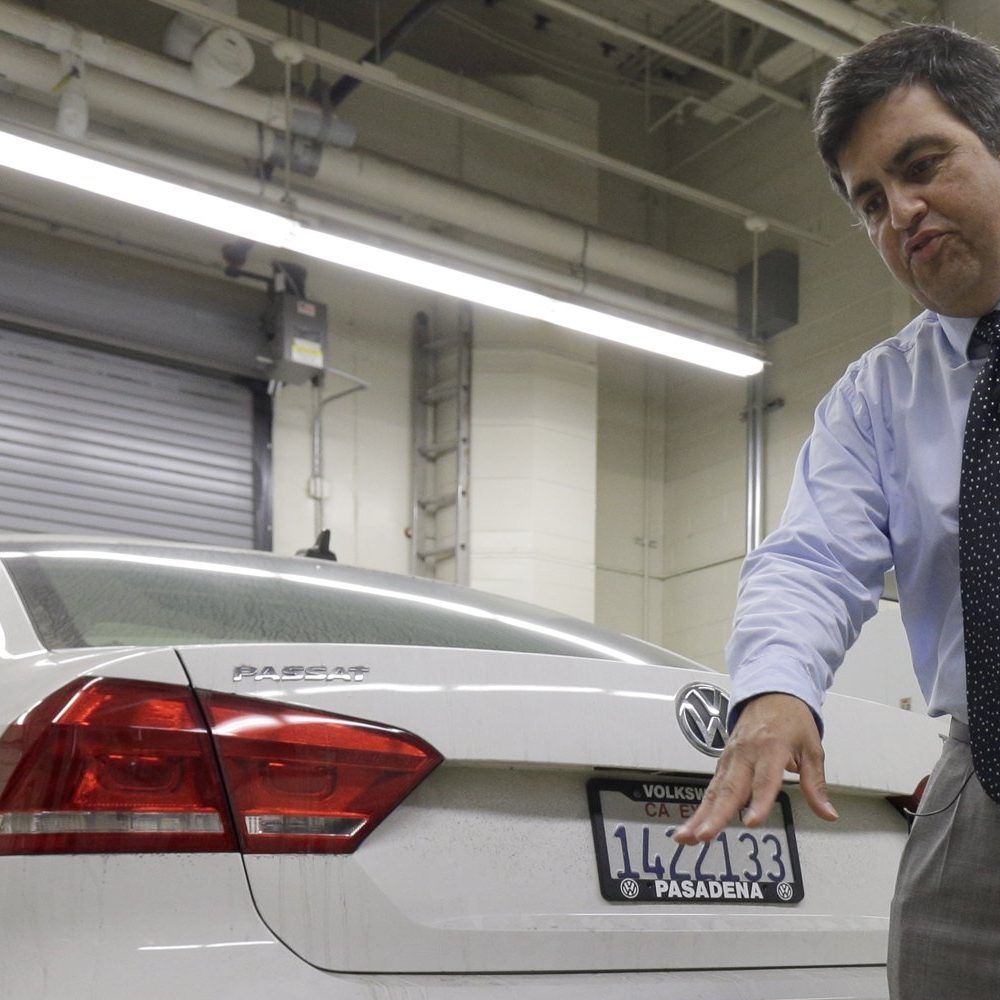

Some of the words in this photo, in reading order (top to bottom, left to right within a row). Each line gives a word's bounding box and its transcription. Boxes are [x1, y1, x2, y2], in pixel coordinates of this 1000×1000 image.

[233, 665, 369, 681] PASSAT
[643, 783, 706, 800] VOLKSW
[645, 802, 670, 818] CA
[655, 880, 764, 899] PASADENA
